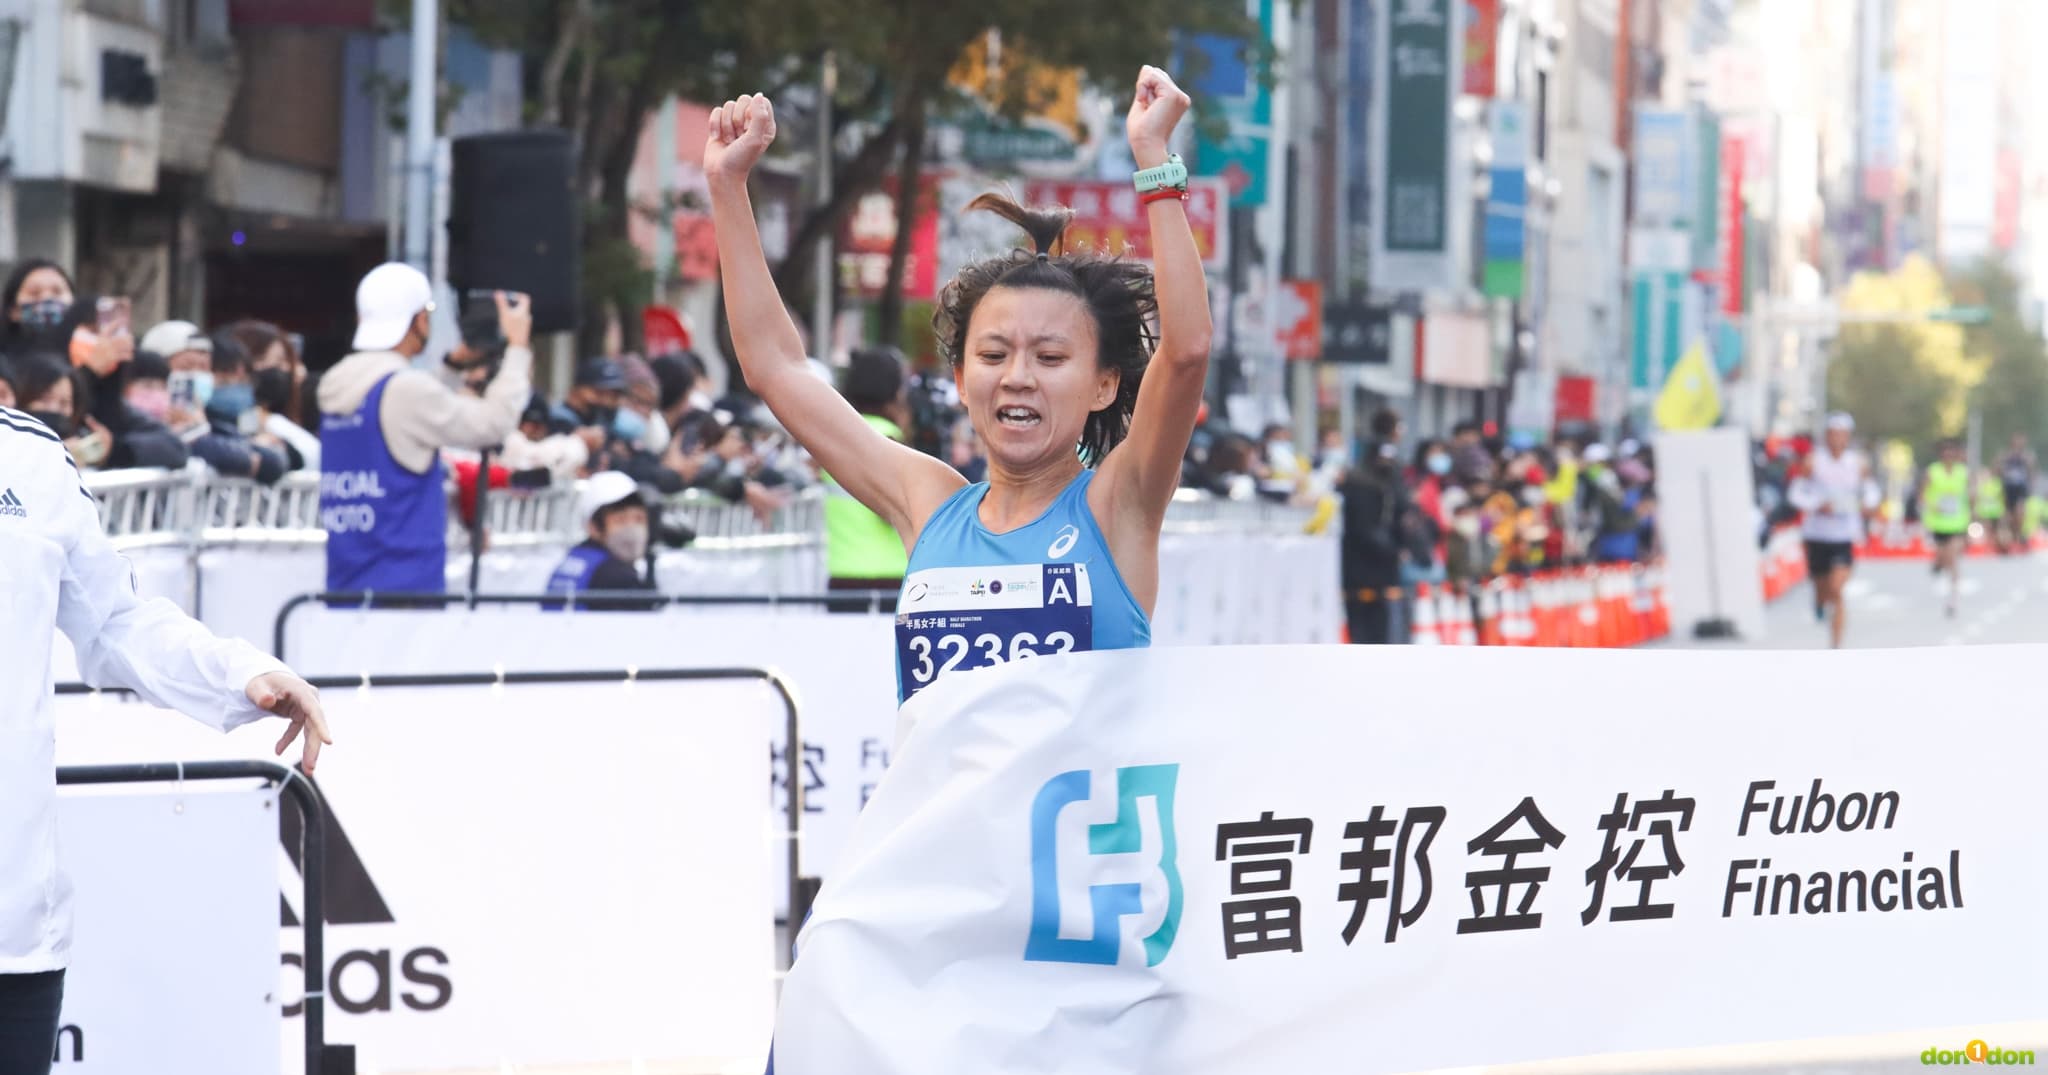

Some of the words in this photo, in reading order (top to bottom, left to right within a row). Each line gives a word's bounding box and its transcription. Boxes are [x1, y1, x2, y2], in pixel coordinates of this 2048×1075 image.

[0, 505, 28, 518] didas
[1047, 578, 1074, 605] A
[905, 616, 947, 631] 半馬女子組
[1738, 778, 1900, 836] Fubon
[1215, 789, 1696, 960] 富邦金控
[1722, 849, 1964, 918] Financial
